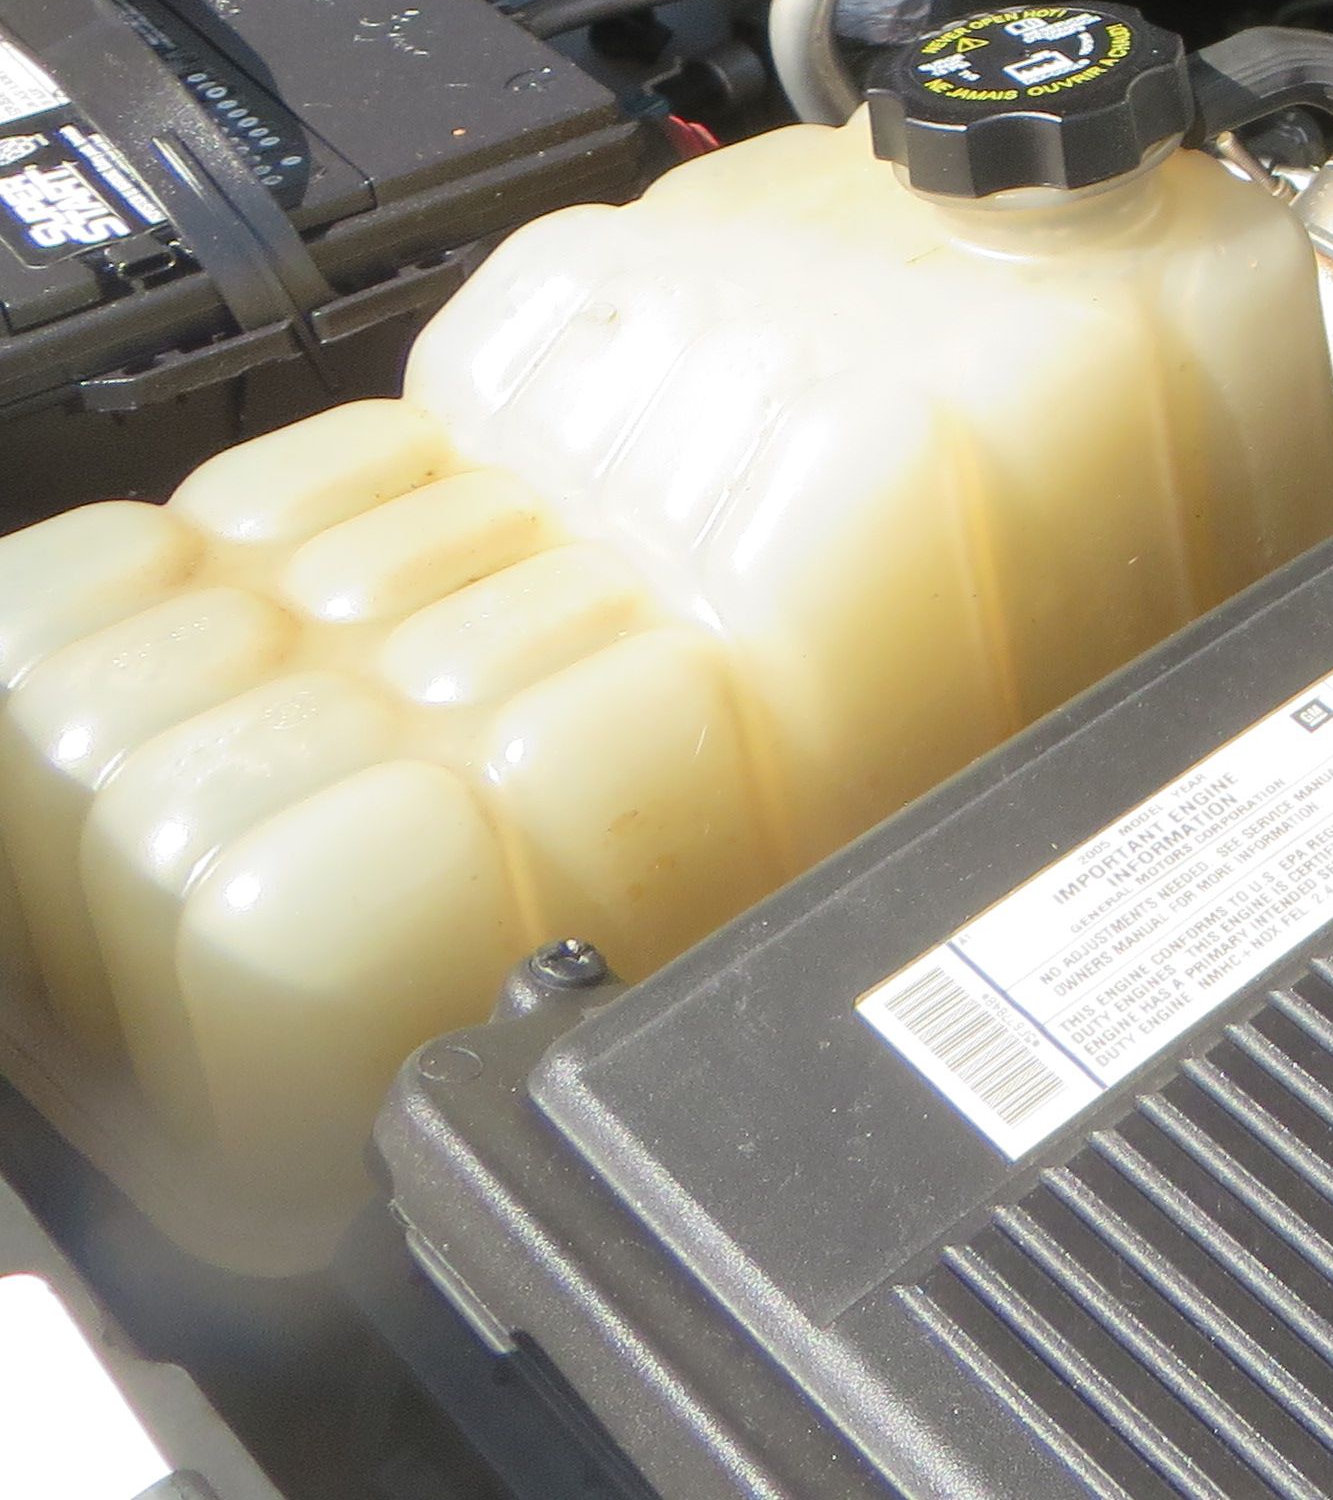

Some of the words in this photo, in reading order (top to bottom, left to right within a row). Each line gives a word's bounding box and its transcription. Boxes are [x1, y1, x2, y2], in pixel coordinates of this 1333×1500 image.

[920, 26, 972, 55] NEVER
[969, 11, 1018, 30] OPEN
[923, 78, 955, 93] NE
[946, 86, 1019, 101] JAMAIS
[1027, 67, 1109, 97] OUVRIR
[0, 174, 66, 247] SUPER
[24, 164, 132, 244] START
[1300, 705, 1323, 723] GM
[1052, 820, 1165, 905] IMPORTANT
[1167, 771, 1239, 824] ENGINE
[1070, 887, 1134, 934] GENERAL
[1134, 842, 1194, 886] MOTORS
[1193, 778, 1286, 845] CORPORATION
[1077, 840, 1112, 866] 2005
[1117, 804, 1164, 837] MODEL
[1170, 773, 1208, 798] YEAR
[1106, 792, 1239, 888] INFORMATION
[1039, 966, 1062, 985] NO
[1062, 896, 1159, 969] ADJUSTMENTS
[1215, 836, 1244, 858] SEE
[1241, 799, 1295, 840] SERVICE
[1053, 950, 1114, 997] OWNERS
[1111, 913, 1170, 956] MANUAL
[1168, 889, 1198, 913] FOR
[1195, 861, 1236, 893] MORE
[1057, 1004, 1096, 1033] THIS
[1095, 963, 1151, 1007] ENGINE
[1150, 905, 1229, 966] CONFORMS
[1226, 890, 1250, 907] TO
[1277, 848, 1309, 872] EPA
[1070, 1010, 1111, 1045] DUTY
[1183, 930, 1221, 958] THIS
[1219, 892, 1273, 934] ENGINE
[1270, 880, 1289, 896] IS
[1083, 1011, 1141, 1057] ENGINE
[1138, 987, 1172, 1014] HAS
[1171, 978, 1185, 991] A
[1183, 927, 1249, 980] PRIMARY
[1249, 877, 1318, 931] INTENDED
[1094, 1032, 1136, 1068] DUTY
[1137, 991, 1194, 1035] ENGINE
[1249, 923, 1283, 950] NOX
[1279, 906, 1310, 927] FEL
